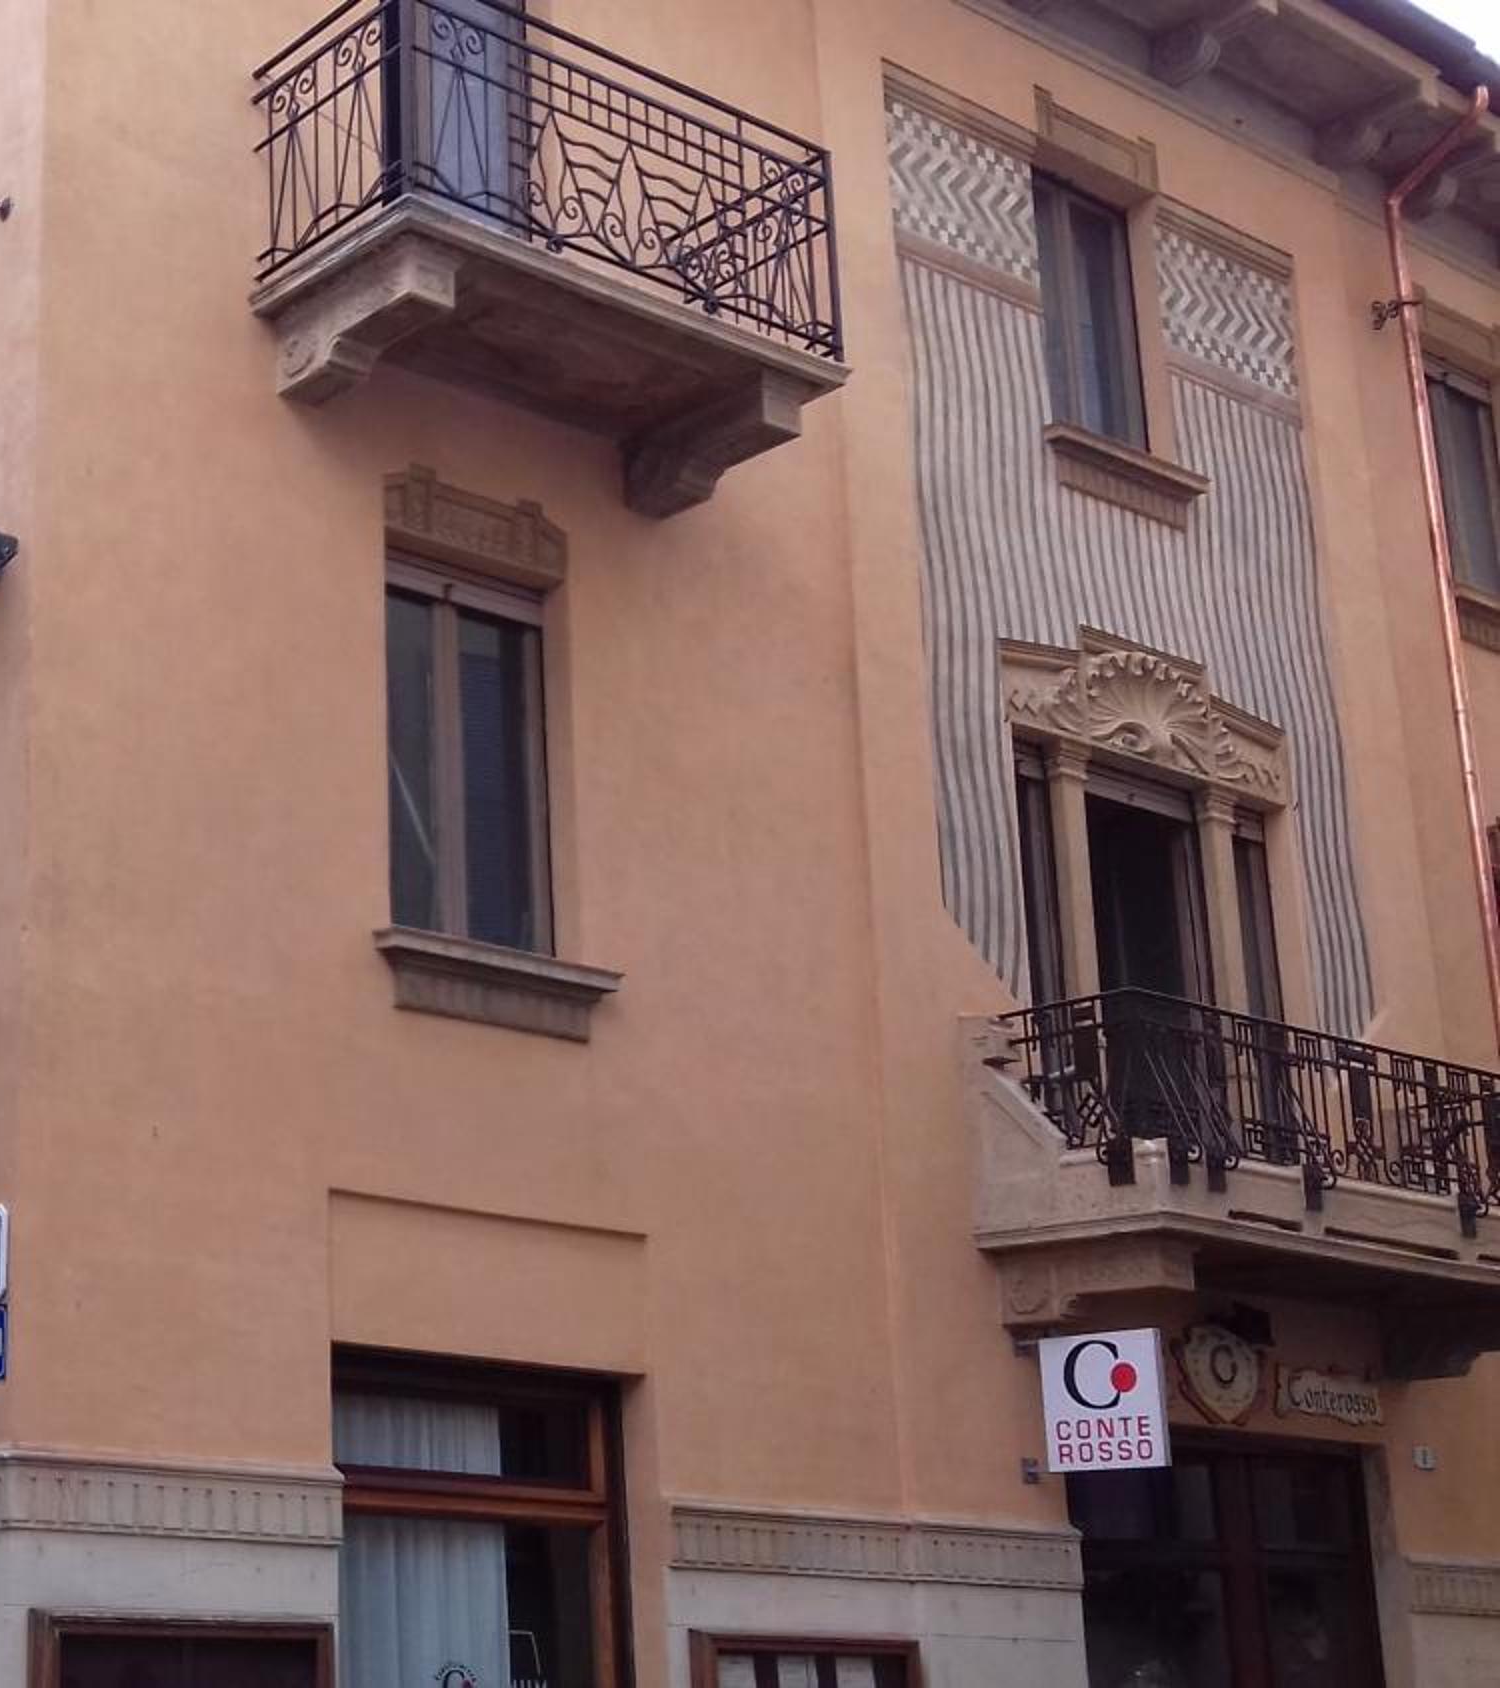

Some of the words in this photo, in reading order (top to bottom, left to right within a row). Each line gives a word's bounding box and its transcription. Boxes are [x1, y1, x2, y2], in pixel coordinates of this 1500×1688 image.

[1063, 1340, 1121, 1410] C
[1287, 1374, 1377, 1417] Conterosso
[1056, 1416, 1151, 1441] CONTE
[1058, 1440, 1153, 1464] ROSSO
